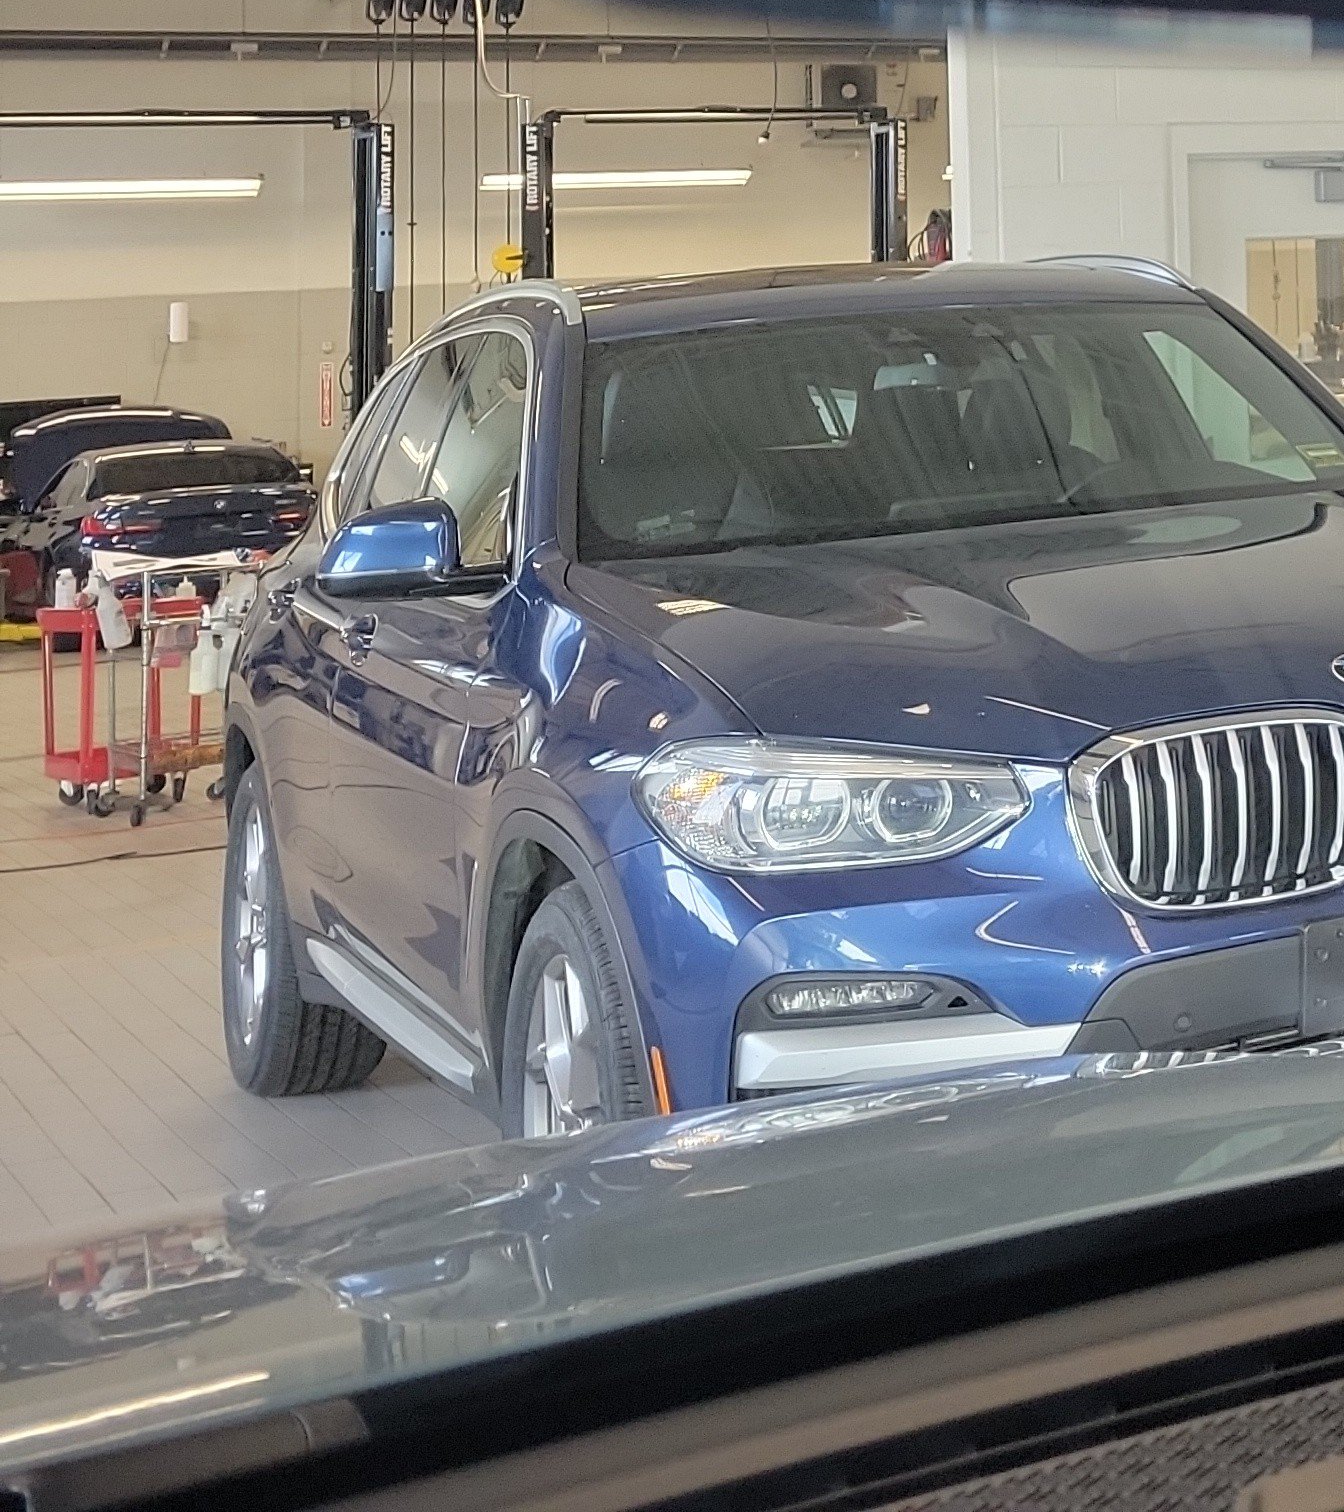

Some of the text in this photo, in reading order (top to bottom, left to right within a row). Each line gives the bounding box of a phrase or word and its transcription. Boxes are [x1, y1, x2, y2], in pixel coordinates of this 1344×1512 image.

[381, 124, 392, 207] ROTARY LIFT
[526, 125, 538, 204] ROTARY LIFT
